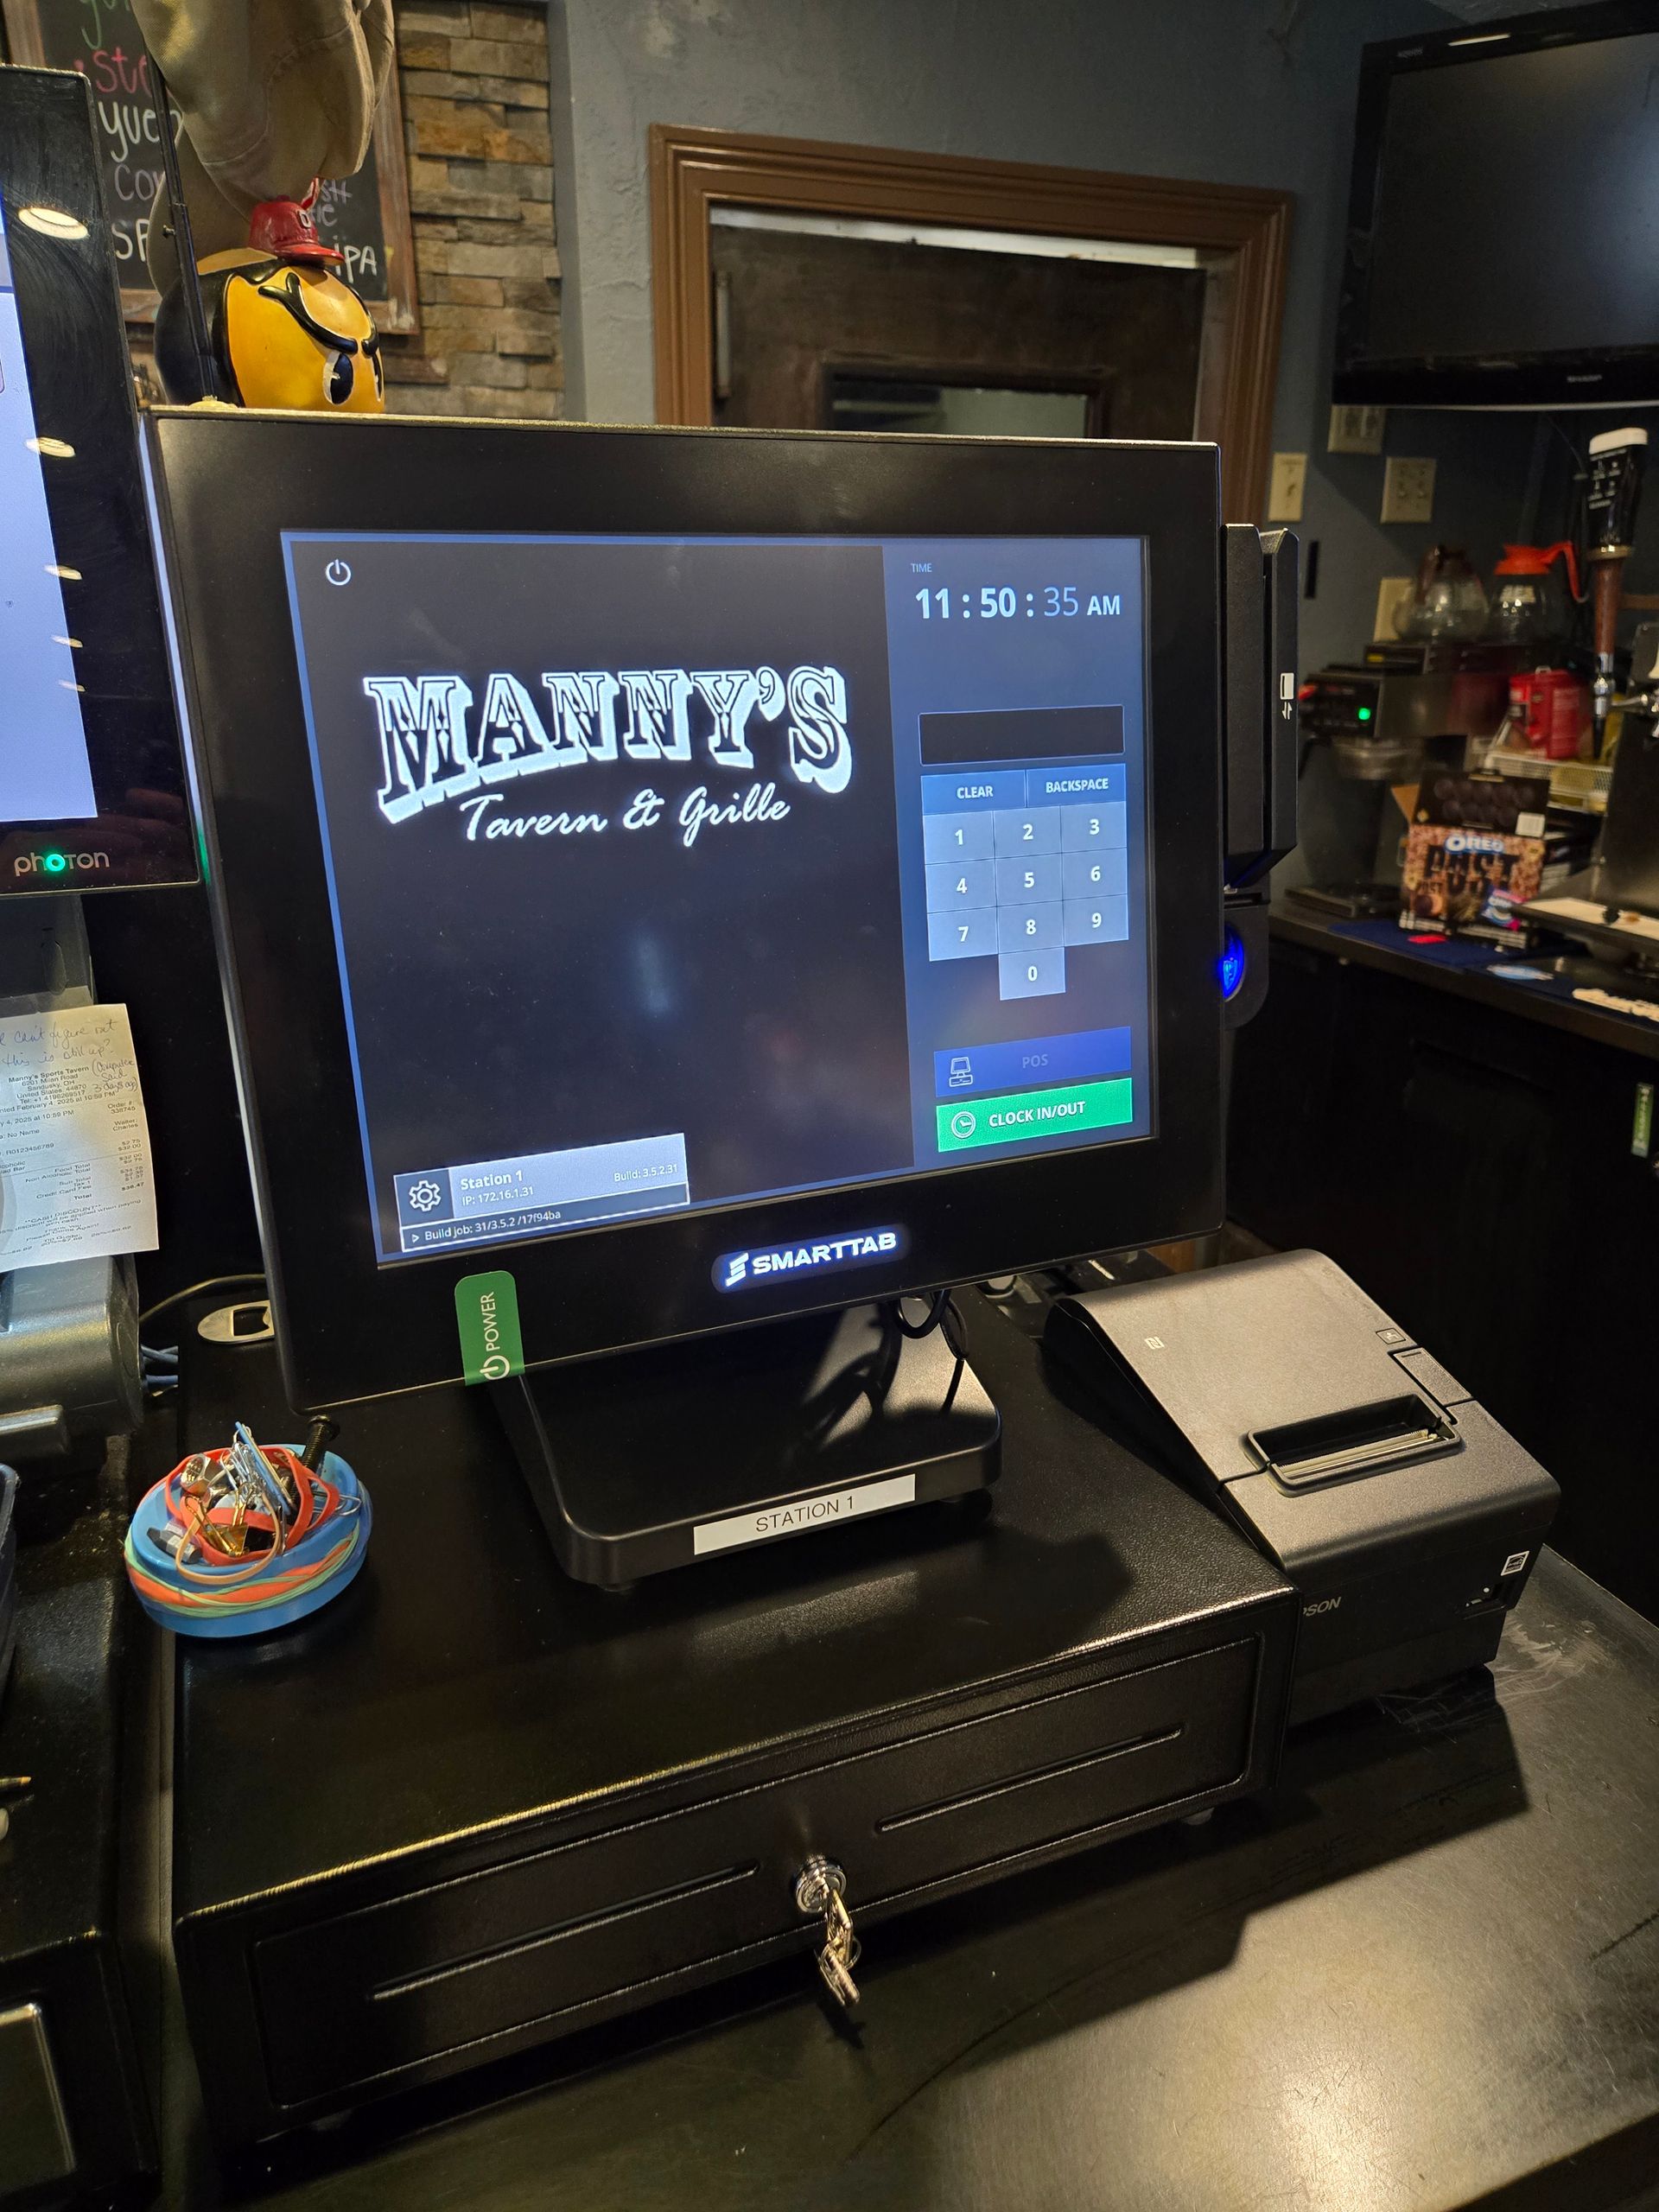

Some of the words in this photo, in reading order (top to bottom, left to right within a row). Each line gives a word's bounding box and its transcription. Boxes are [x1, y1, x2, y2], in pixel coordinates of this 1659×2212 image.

[911, 563, 932, 573] TIME
[1087, 594, 1121, 615] AM
[361, 664, 855, 824] MANNY'S
[957, 785, 994, 799] CLEAR
[1046, 778, 1109, 794] BACKSPACE
[459, 792, 607, 842] Tavern
[623, 787, 665, 830] &
[678, 781, 790, 849] Grille
[955, 830, 964, 846] 1
[1022, 823, 1033, 841] 2
[1089, 818, 1100, 836] 3
[1446, 835, 1504, 853] OREO
[957, 878, 968, 894] 4
[1024, 872, 1034, 888] 5
[1090, 866, 1101, 882] 6
[958, 925, 969, 943] 7
[1026, 919, 1036, 935] 8
[1091, 912, 1102, 928] 9
[1027, 966, 1038, 982] 0
[1022, 1053, 1049, 1069] POS
[9, 1072, 39, 1084] Manny's
[40, 1070, 64, 1080] Sports
[65, 1065, 90, 1075] Tavern
[60, 1073, 79, 1082] Road
[16, 1091, 40, 1100] United
[16, 1100, 48, 1112] February
[107, 1102, 126, 1110] Order
[988, 1109, 1034, 1128] CLOCK
[1037, 1101, 1086, 1121] IN/OUT
[15, 1116, 33, 1125] 2025
[42, 1111, 62, 1121] 10:59
[19, 1128, 41, 1137] Name
[460, 1171, 512, 1191] Station
[515, 1170, 524, 1183] 1
[613, 1169, 642, 1183] Build:
[643, 1163, 678, 1178] 3.5.2.31
[462, 1194, 476, 1206] IP:
[478, 1185, 534, 1205] 172.16.1.31
[424, 1226, 452, 1242] Build
[453, 1224, 474, 1239] job:
[753, 1230, 898, 1276] SMARTTAB
[481, 1290, 496, 1352] POWER
[755, 1499, 839, 1533] STATION
[847, 1496, 855, 1510] 1
